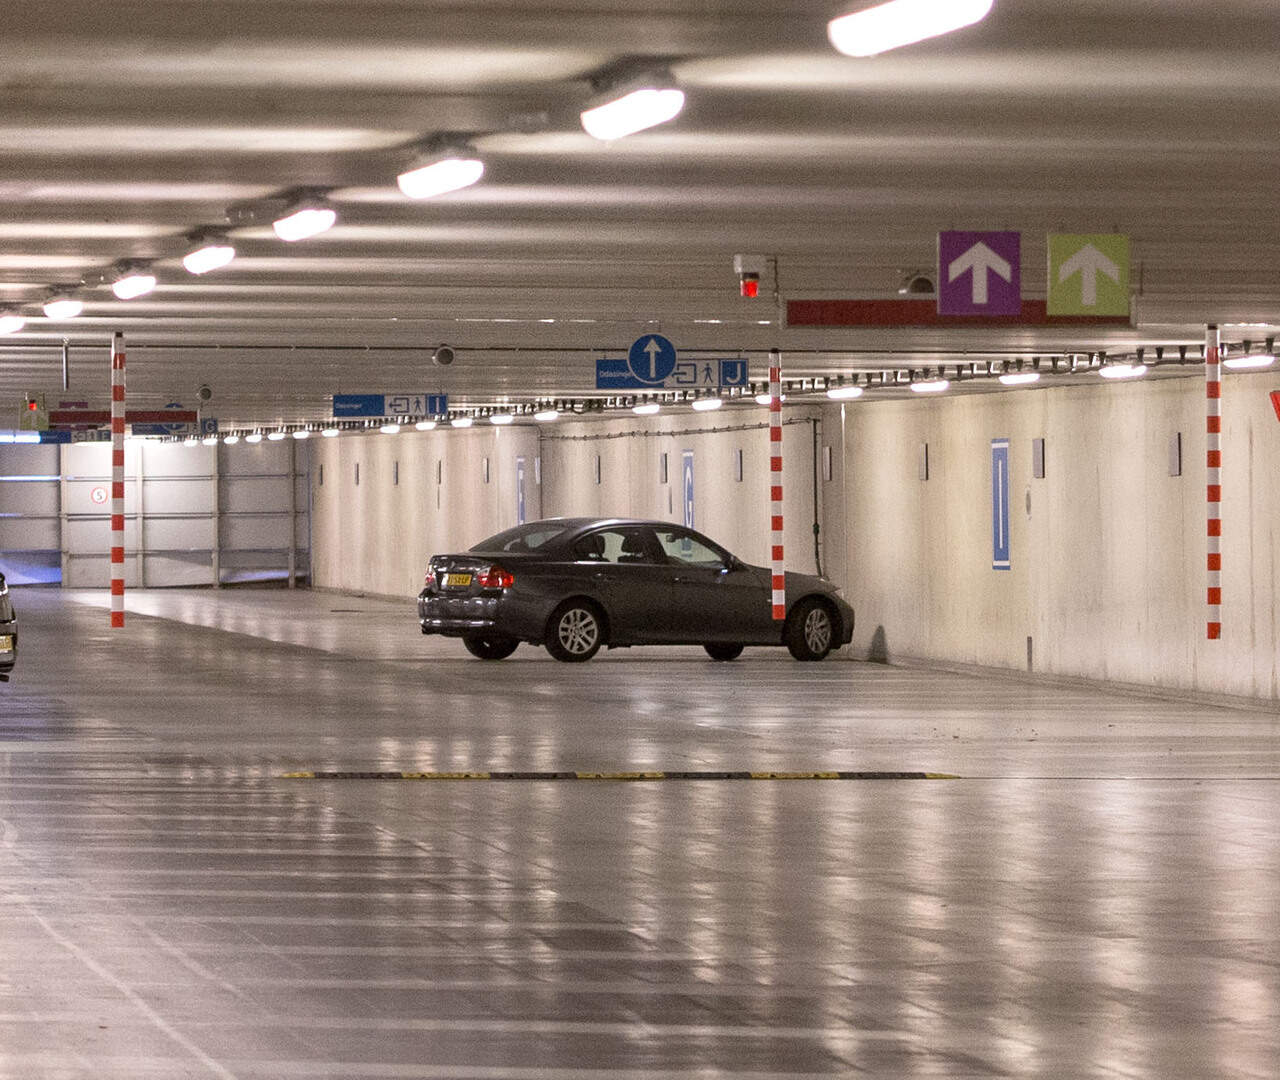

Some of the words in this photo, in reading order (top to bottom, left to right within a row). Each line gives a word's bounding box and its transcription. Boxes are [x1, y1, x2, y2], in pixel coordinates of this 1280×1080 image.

[726, 363, 742, 383] J
[96, 490, 103, 501] 5
[685, 466, 693, 529] G
[999, 460, 1003, 549] I
